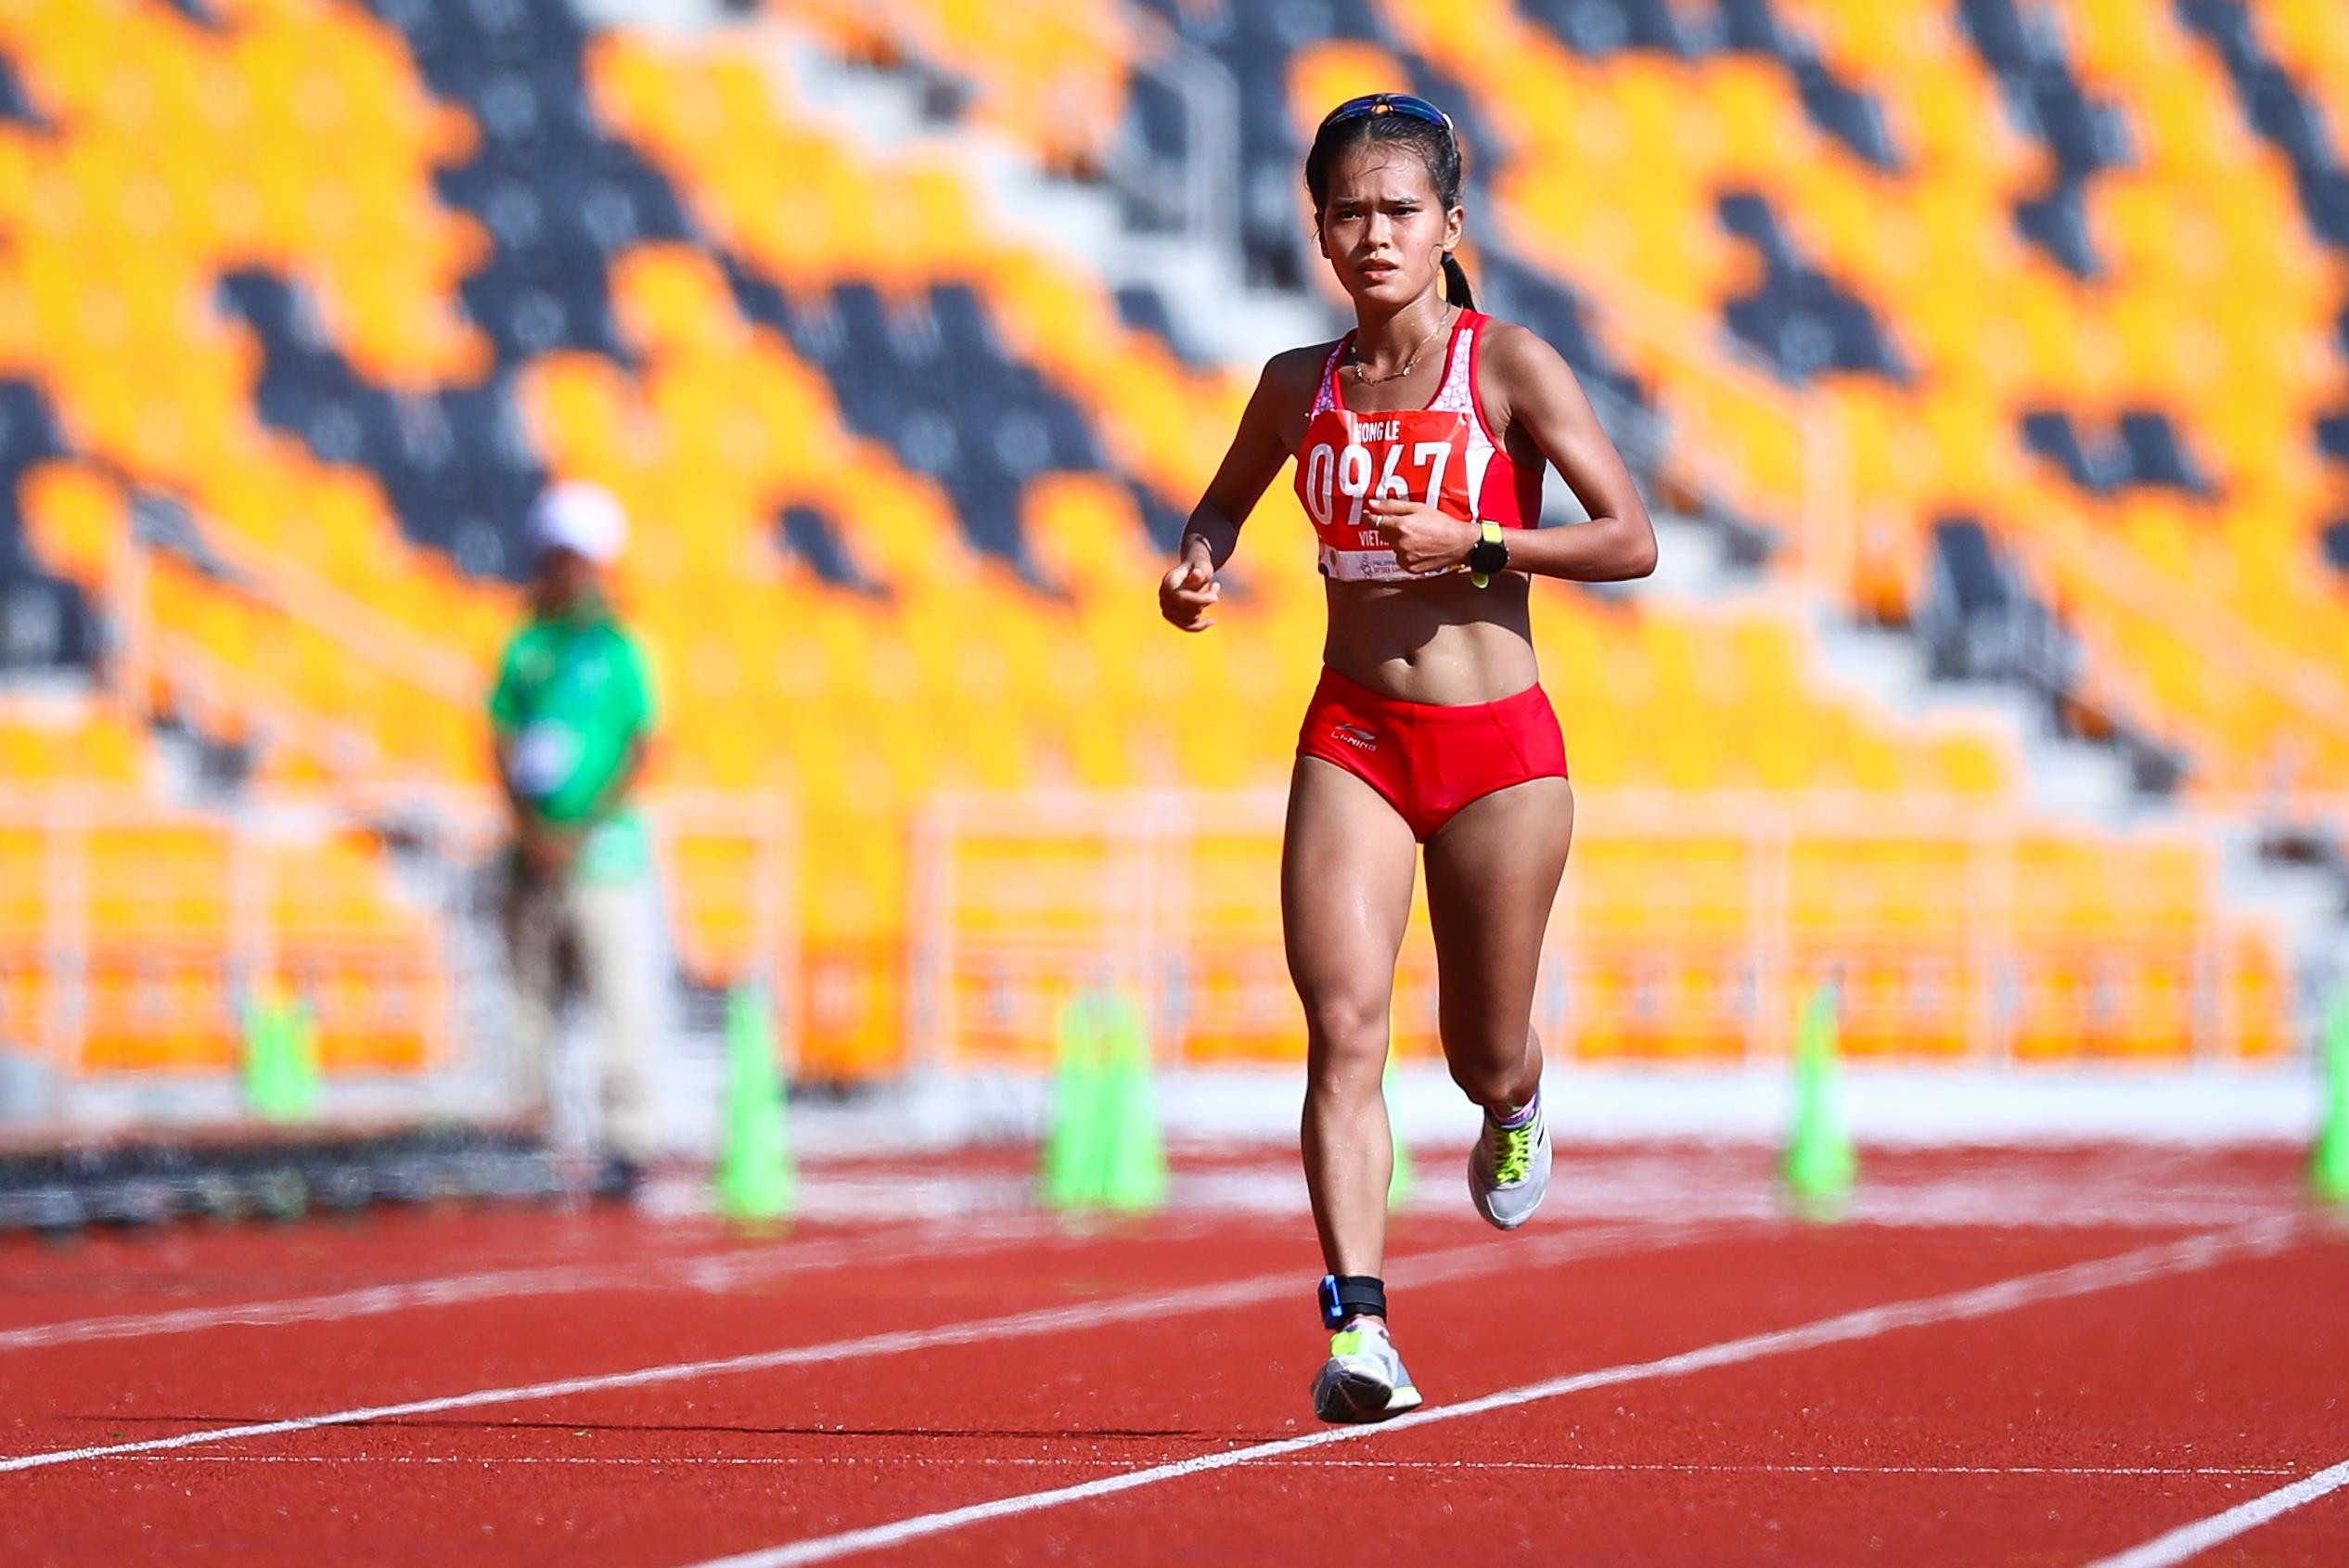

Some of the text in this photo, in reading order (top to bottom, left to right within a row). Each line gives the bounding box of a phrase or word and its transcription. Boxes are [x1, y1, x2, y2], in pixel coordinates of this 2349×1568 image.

[1384, 419, 1401, 441] LE
[1305, 441, 1452, 526] 0967
[1357, 529, 1390, 547] VIET
